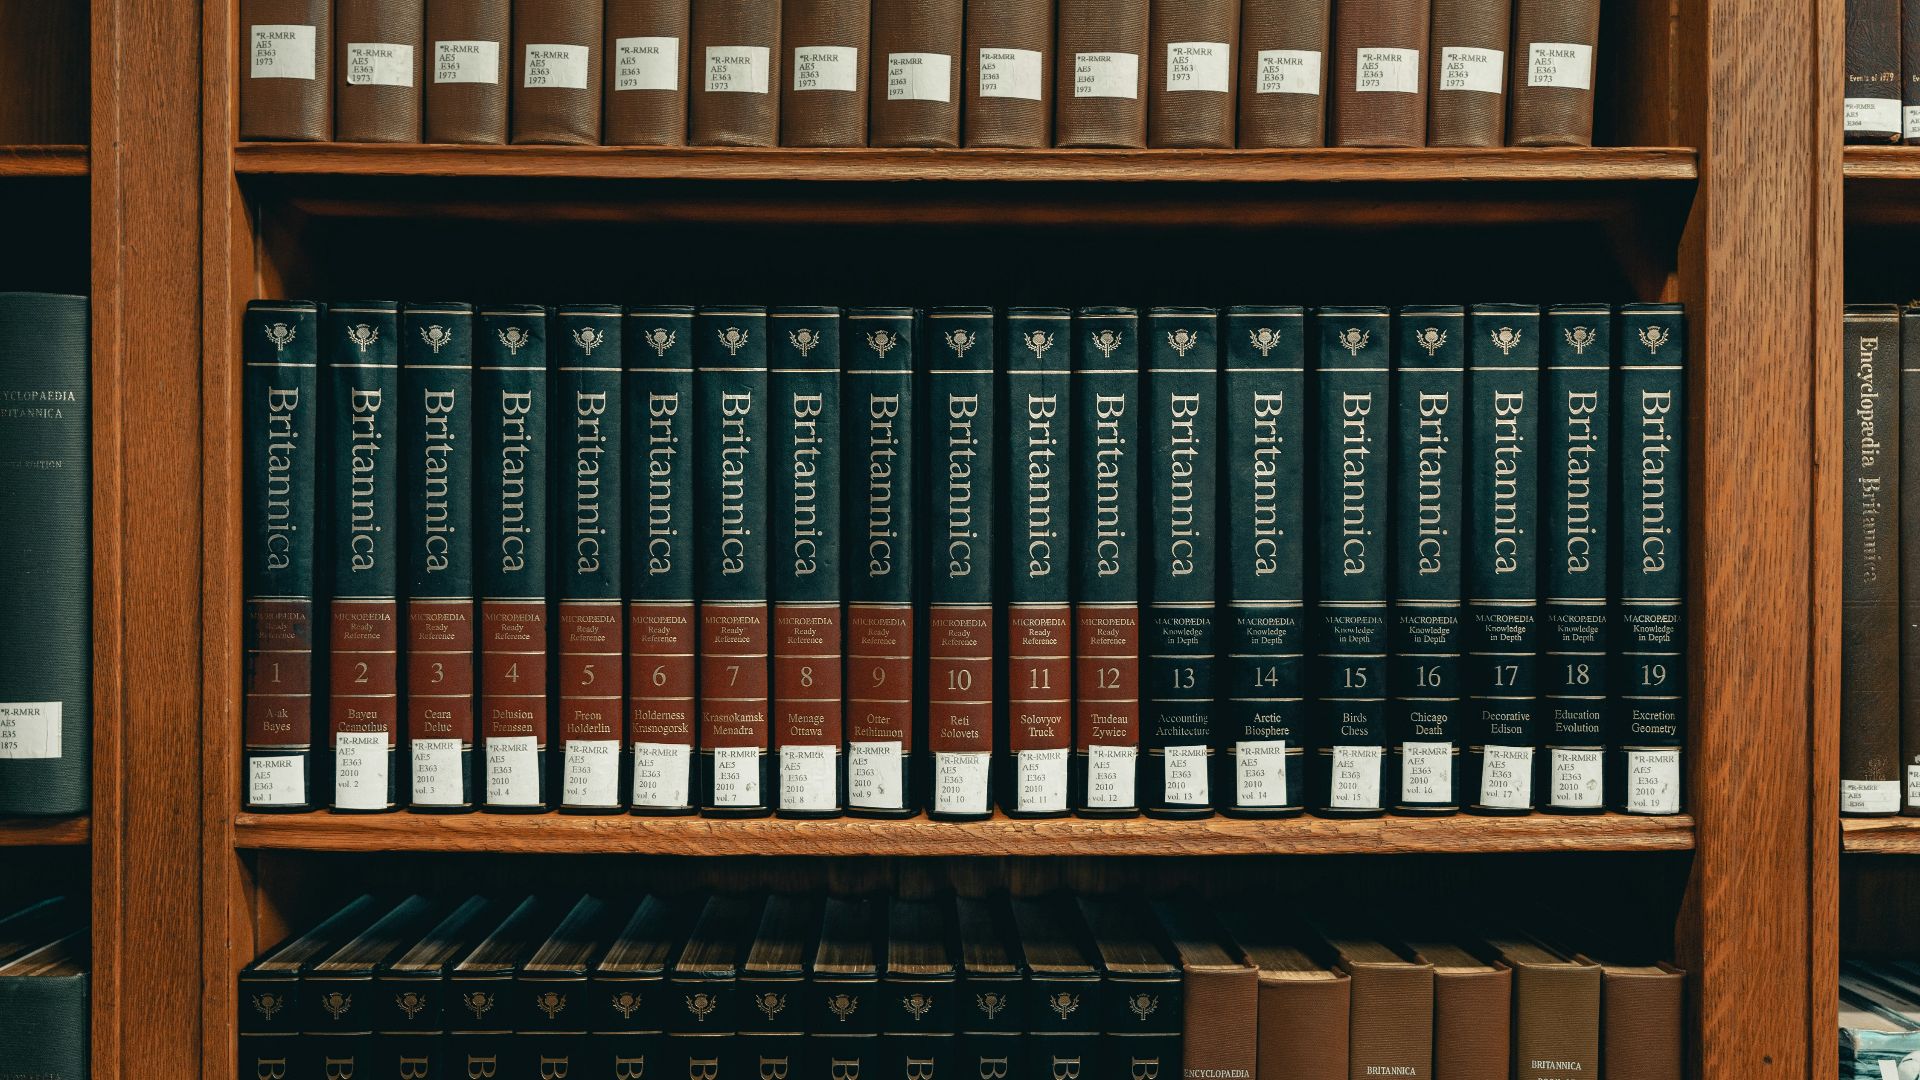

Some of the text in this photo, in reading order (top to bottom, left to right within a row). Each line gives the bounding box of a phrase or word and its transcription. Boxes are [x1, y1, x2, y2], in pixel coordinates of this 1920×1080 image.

[439, 71, 456, 79] 1973
[1172, 73, 1190, 81] 1973
[1534, 75, 1552, 83] 1973
[799, 79, 816, 87] 1973
[1856, 335, 1880, 467] Encyclopædia
[268, 387, 298, 571] Britannica
[352, 387, 381, 572] Britannica
[425, 389, 454, 573] Britannica
[503, 390, 531, 573] Britannica
[577, 391, 606, 574] Britannica
[650, 392, 678, 576] Britannica
[722, 391, 751, 576] Britannica
[794, 392, 822, 576] Britannica
[870, 393, 898, 576] Britannica
[1097, 393, 1125, 577] Britannica
[1172, 392, 1199, 577] Britannica
[1254, 391, 1283, 576] Britannica
[1343, 392, 1371, 576] Britannica
[1419, 391, 1448, 576] Britannica
[1495, 390, 1523, 574] Britannica
[1568, 390, 1597, 574] Britannica
[1643, 389, 1671, 574] Britannica
[950, 393, 978, 578] Britannica
[1026, 394, 1057, 578] Britannica
[272, 663, 281, 683] 1
[354, 662, 369, 682] 2
[431, 662, 444, 682] 3
[505, 662, 519, 682] 4
[581, 665, 594, 685] 5
[652, 665, 666, 686] 6
[727, 666, 739, 686] 7
[801, 666, 813, 687] 8
[872, 667, 885, 687] 9
[1173, 668, 1195, 688] 13
[1254, 666, 1278, 687] 14
[1344, 667, 1367, 688] 15
[1416, 666, 1441, 686] 16
[1494, 666, 1518, 686] 17
[1566, 664, 1589, 684] 18
[1641, 665, 1666, 685] 19
[948, 669, 971, 690] 10
[1030, 668, 1050, 689] 11
[1097, 668, 1120, 689] 12
[265, 709, 288, 718] A-ak
[348, 709, 377, 720] Bayeu
[425, 709, 451, 719] Ceara
[493, 709, 533, 719] Delusion
[575, 711, 601, 720] Freon
[635, 710, 684, 720] Holderness
[704, 713, 764, 722] Krasnokamsk
[789, 713, 824, 724] Menage
[867, 714, 890, 724] Otter
[1091, 714, 1127, 724] Trudeau
[1159, 713, 1208, 725] Accounting
[1254, 713, 1281, 723] Arctic
[1344, 713, 1367, 723] Birds
[1411, 712, 1447, 724] Chicago
[1483, 711, 1530, 721] Decorative
[1555, 710, 1599, 720] Education
[1633, 710, 1675, 720] Excretion
[951, 716, 969, 725] Reti
[1021, 715, 1061, 726] Solovyov
[263, 722, 290, 732] Bayes
[339, 722, 387, 732] Ceanothus
[425, 722, 451, 732] Deluc
[493, 722, 532, 732] Frenssen
[568, 723, 610, 733] Holderlin
[633, 723, 688, 735] Krasnogorsk
[713, 725, 753, 735] Menadra
[791, 727, 822, 736] Ottawa
[855, 727, 903, 737] Rethimnon
[941, 728, 978, 738] Solovets
[1028, 727, 1054, 737] Truck
[1092, 727, 1126, 737] Zywiec
[1156, 726, 1209, 735] Architecture
[1245, 725, 1289, 737] Biosphere
[1342, 726, 1368, 735] Chess
[1416, 725, 1442, 735] Death
[1491, 724, 1522, 733] Edison
[1556, 723, 1599, 733] Evolution
[1632, 723, 1676, 735] Geometry
[1366, 1066, 1416, 1076] BRITANNICA
[1531, 1060, 1582, 1071] BRITANNICA
[1184, 1069, 1249, 1078] ENCYCLOPAEDIA
